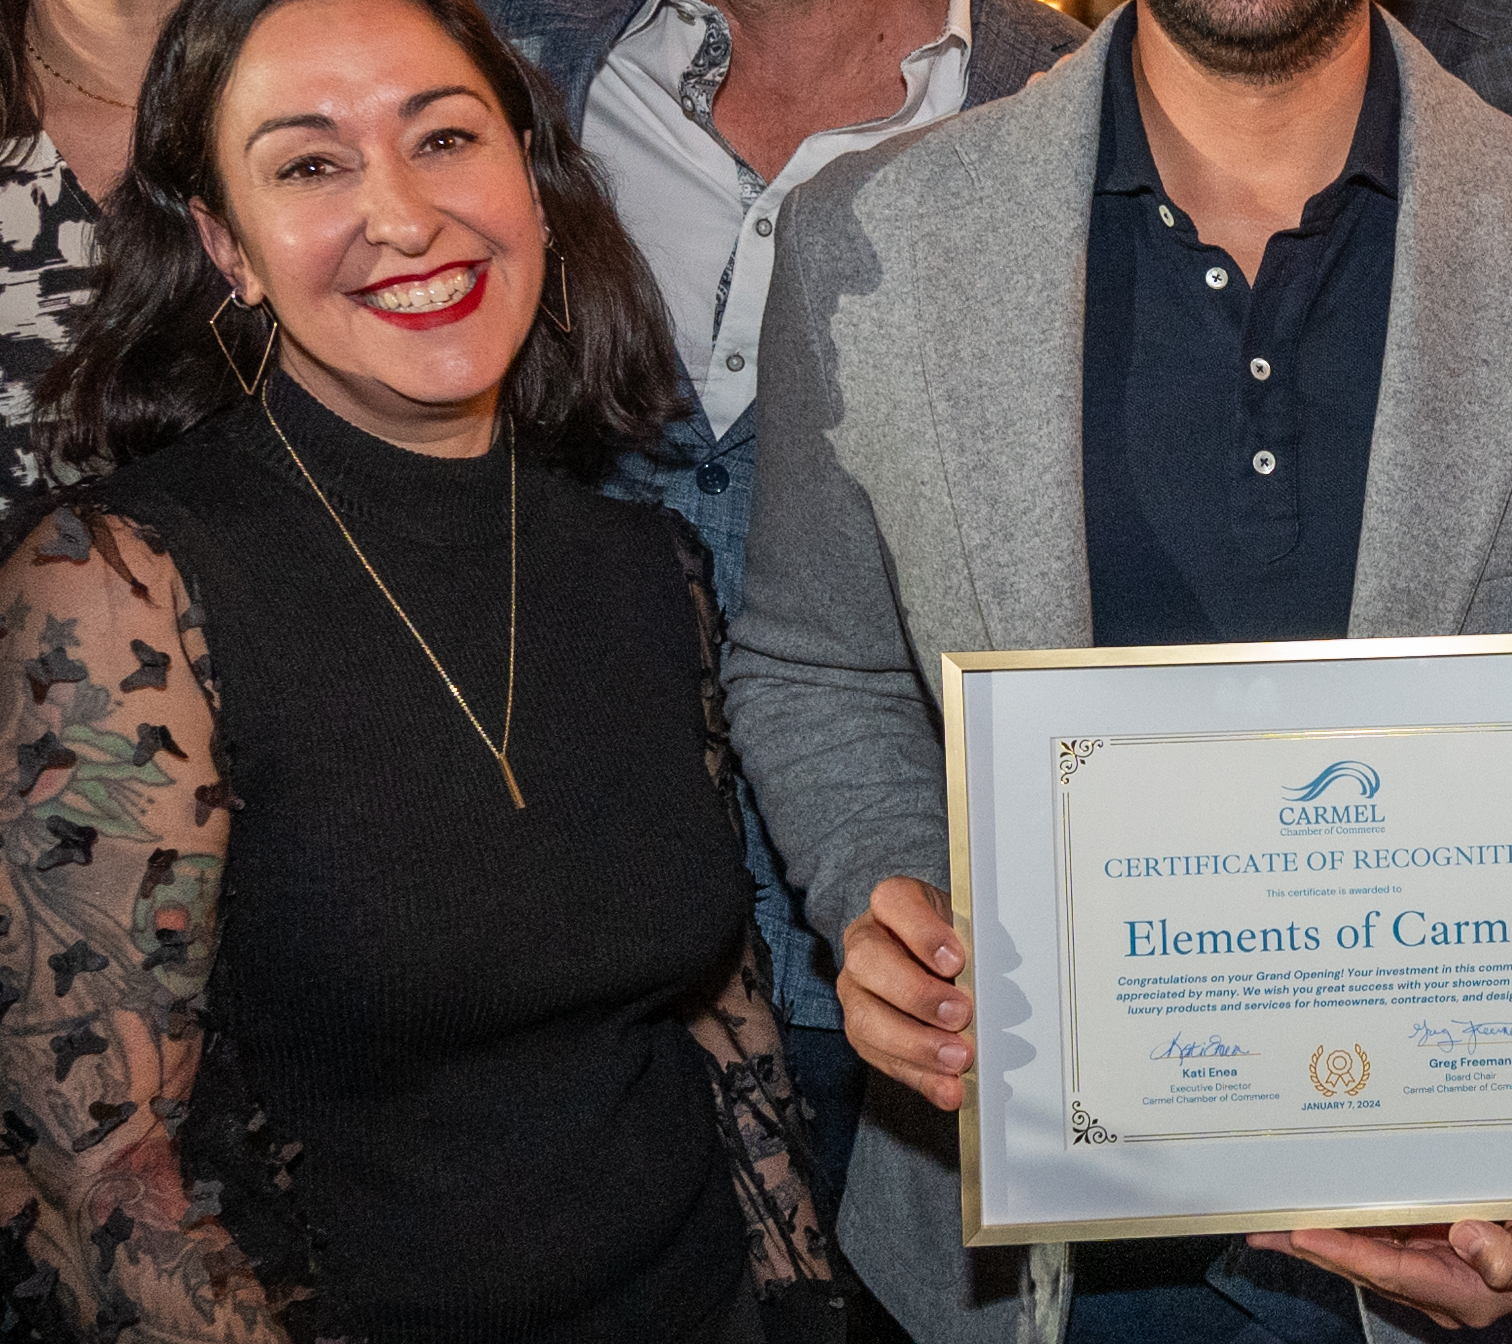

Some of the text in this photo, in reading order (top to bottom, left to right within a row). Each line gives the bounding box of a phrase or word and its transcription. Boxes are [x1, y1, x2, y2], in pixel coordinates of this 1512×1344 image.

[1279, 803, 1386, 826] CARMEL
[1280, 826, 1386, 836] Chamber of Commerce
[1104, 852, 1299, 878] CERTIFICATE
[1306, 850, 1345, 872] OF
[1266, 885, 1402, 898] This certificate is awarded to
[1123, 918, 1321, 957] Elements
[1336, 910, 1381, 949] of
[1117, 973, 1208, 988] Congratulations
[1210, 975, 1225, 983] on
[1228, 973, 1253, 984] your
[1256, 970, 1291, 981] Grand
[1293, 967, 1345, 981] Opening!
[1347, 967, 1374, 977] Your
[1375, 965, 1439, 977] investment
[1441, 964, 1452, 974] in
[1455, 963, 1475, 973] this
[1116, 989, 1186, 1002] appreciated
[1188, 989, 1203, 1000] by
[1205, 989, 1240, 1000] many.
[1242, 987, 1261, 997] We
[1264, 985, 1289, 996] wish
[1292, 986, 1314, 997] you
[1315, 984, 1345, 996] great
[1348, 983, 1394, 993] success
[1397, 980, 1421, 991] with
[1424, 981, 1449, 992] your
[1452, 978, 1511, 989] showroom
[1127, 1005, 1163, 1016] luxury
[1165, 1003, 1217, 1016] products
[1220, 1002, 1242, 1012] and
[1244, 1000, 1291, 1011] services
[1294, 999, 1311, 1009] for
[1313, 997, 1388, 1009] homeowners,
[1390, 994, 1459, 1005] contractors,
[1462, 992, 1484, 1002] and
[1429, 1056, 1512, 1070] Greg Freeman
[1182, 1067, 1238, 1078] Kati Enea
[1445, 1071, 1497, 1082] Board Chair
[1170, 1082, 1251, 1093] Executive Director
[1403, 1085, 1434, 1095] Carmel
[1436, 1083, 1477, 1093] Chamber
[1479, 1083, 1489, 1092] of
[1142, 1092, 1280, 1105] Carmel Chamber of Commerce
[1301, 1099, 1381, 1111] JANUARY 7, 2024
